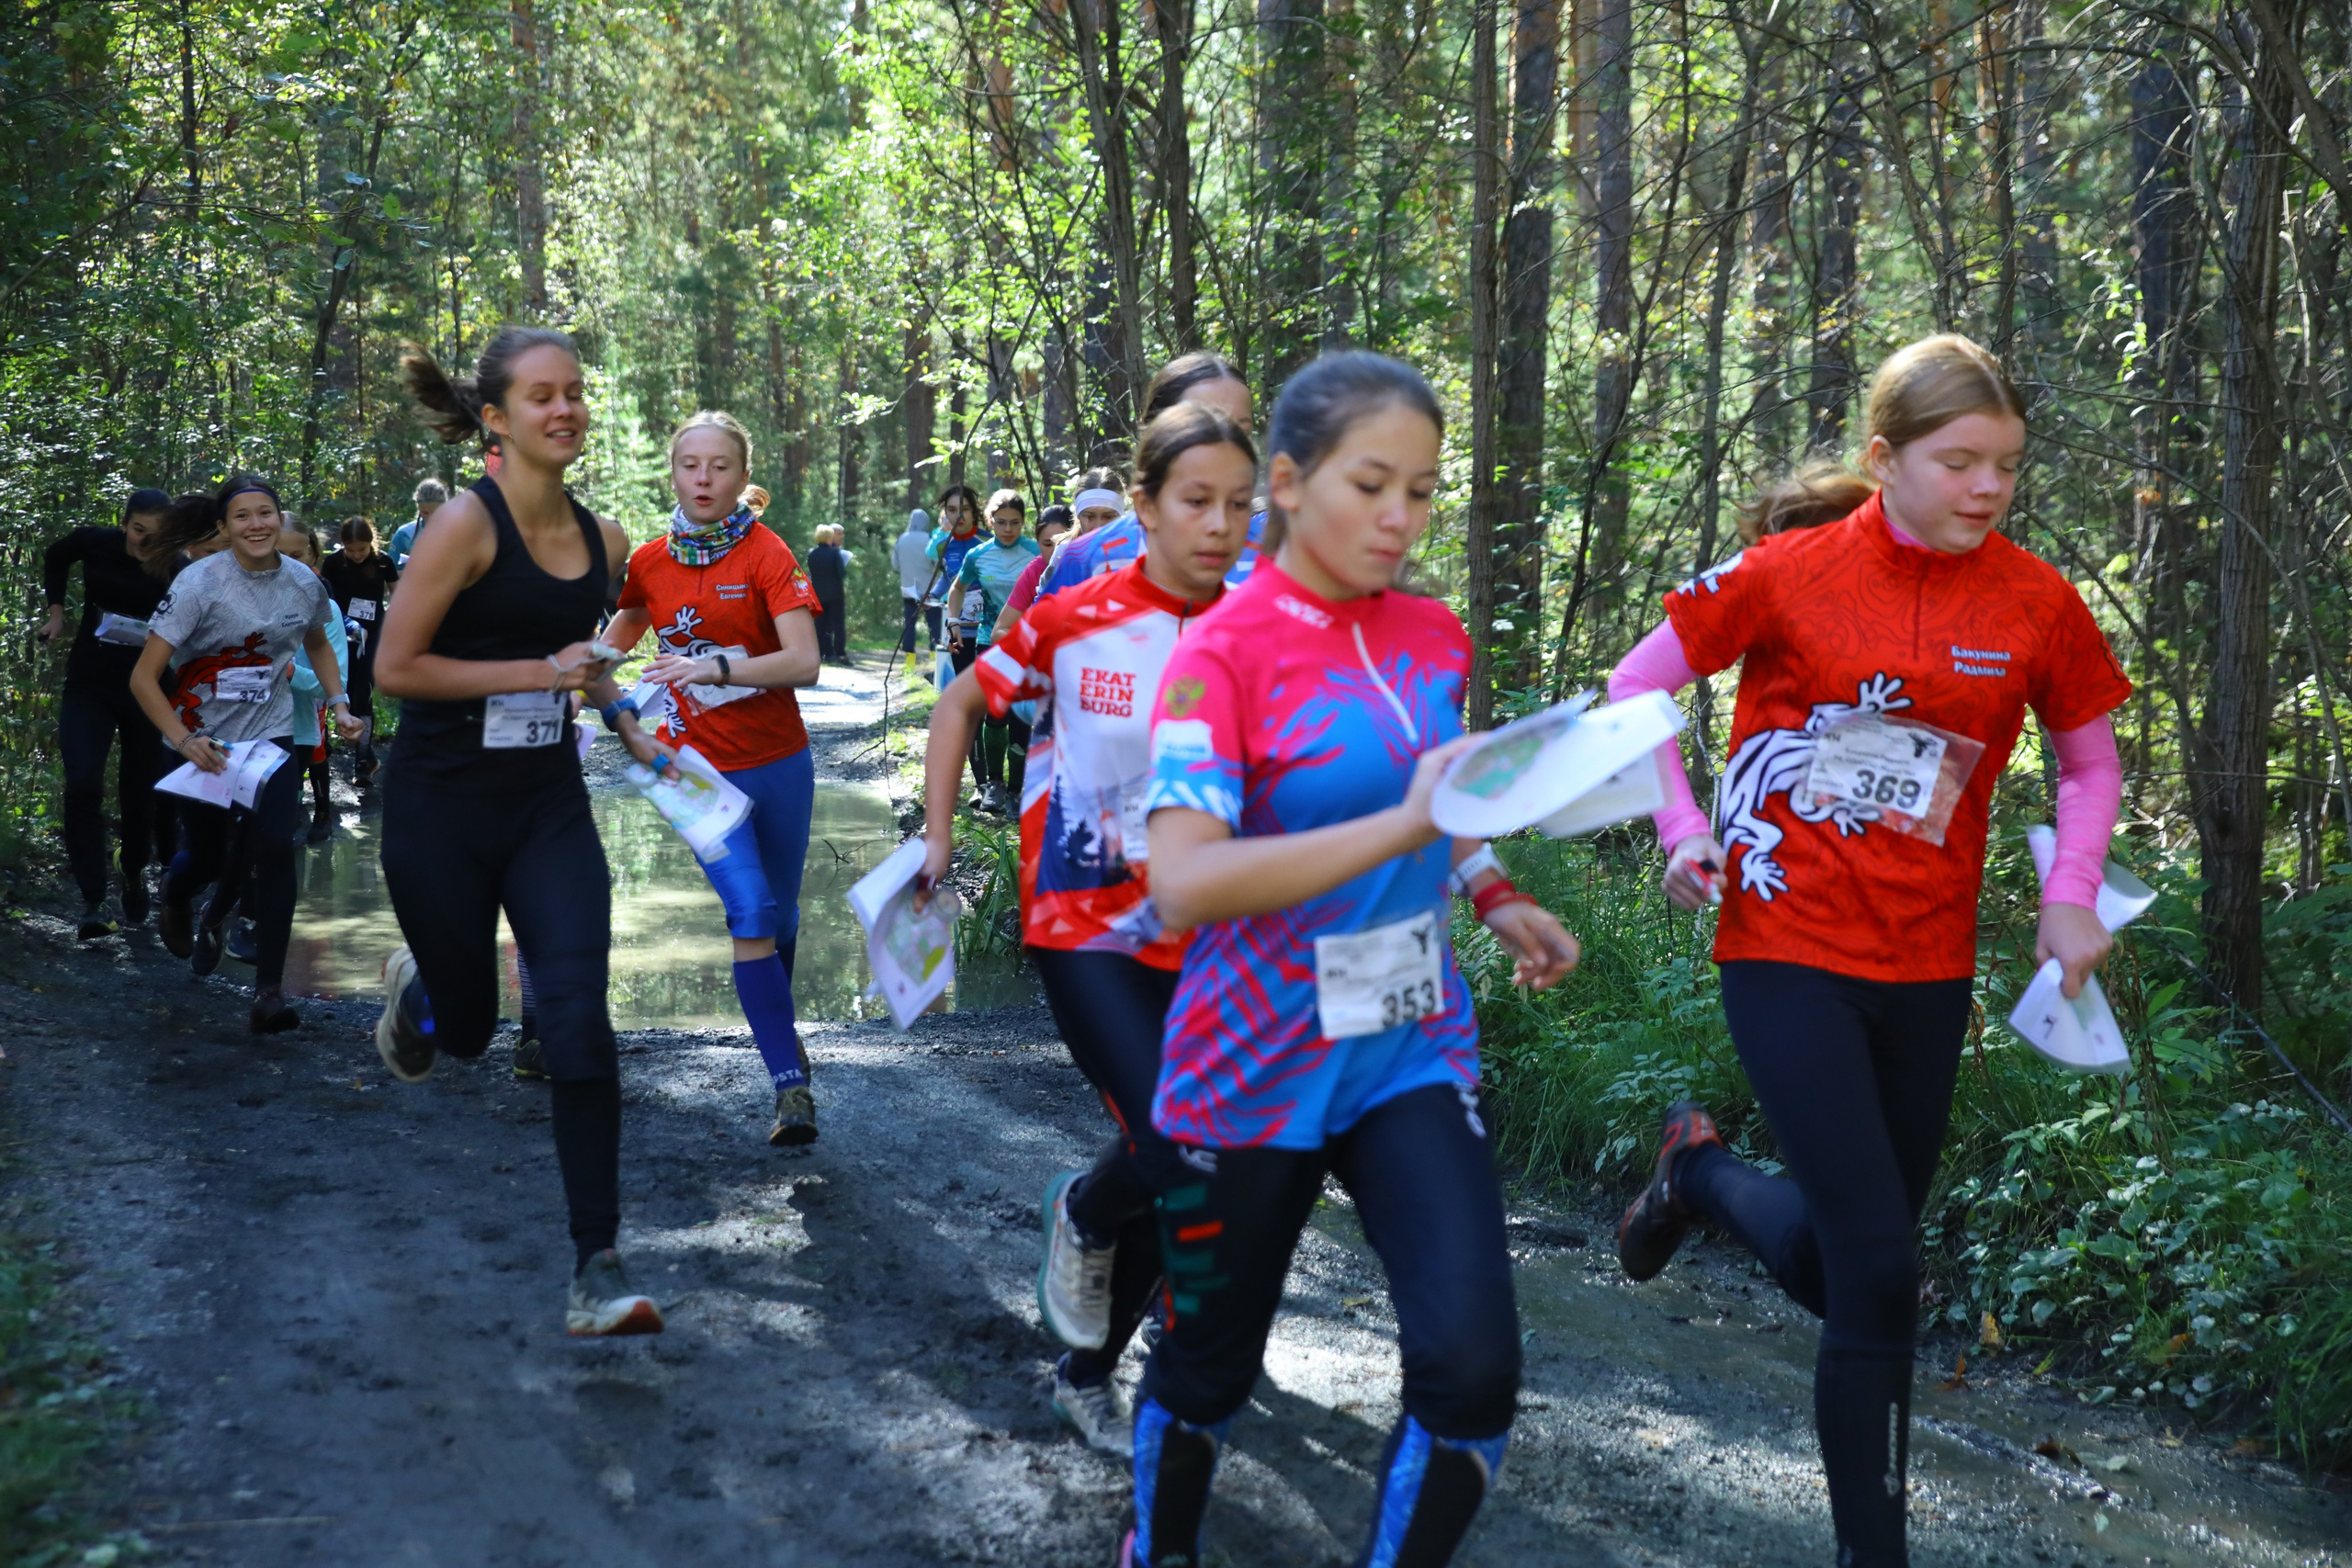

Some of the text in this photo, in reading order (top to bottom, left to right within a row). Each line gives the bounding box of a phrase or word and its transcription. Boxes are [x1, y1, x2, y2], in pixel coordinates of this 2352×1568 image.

[359, 610, 374, 620] 378
[972, 603, 983, 612] 37
[1951, 645, 2011, 661] Бакунина
[1081, 667, 1136, 686] EKAT
[1954, 661, 2007, 677] Радмила
[239, 688, 266, 703] 374
[1080, 682, 1135, 703] ERIN
[1080, 697, 1132, 717] BURG
[526, 719, 560, 743] 371
[1852, 770, 1921, 808] 369
[1382, 978, 1435, 1027] 353
